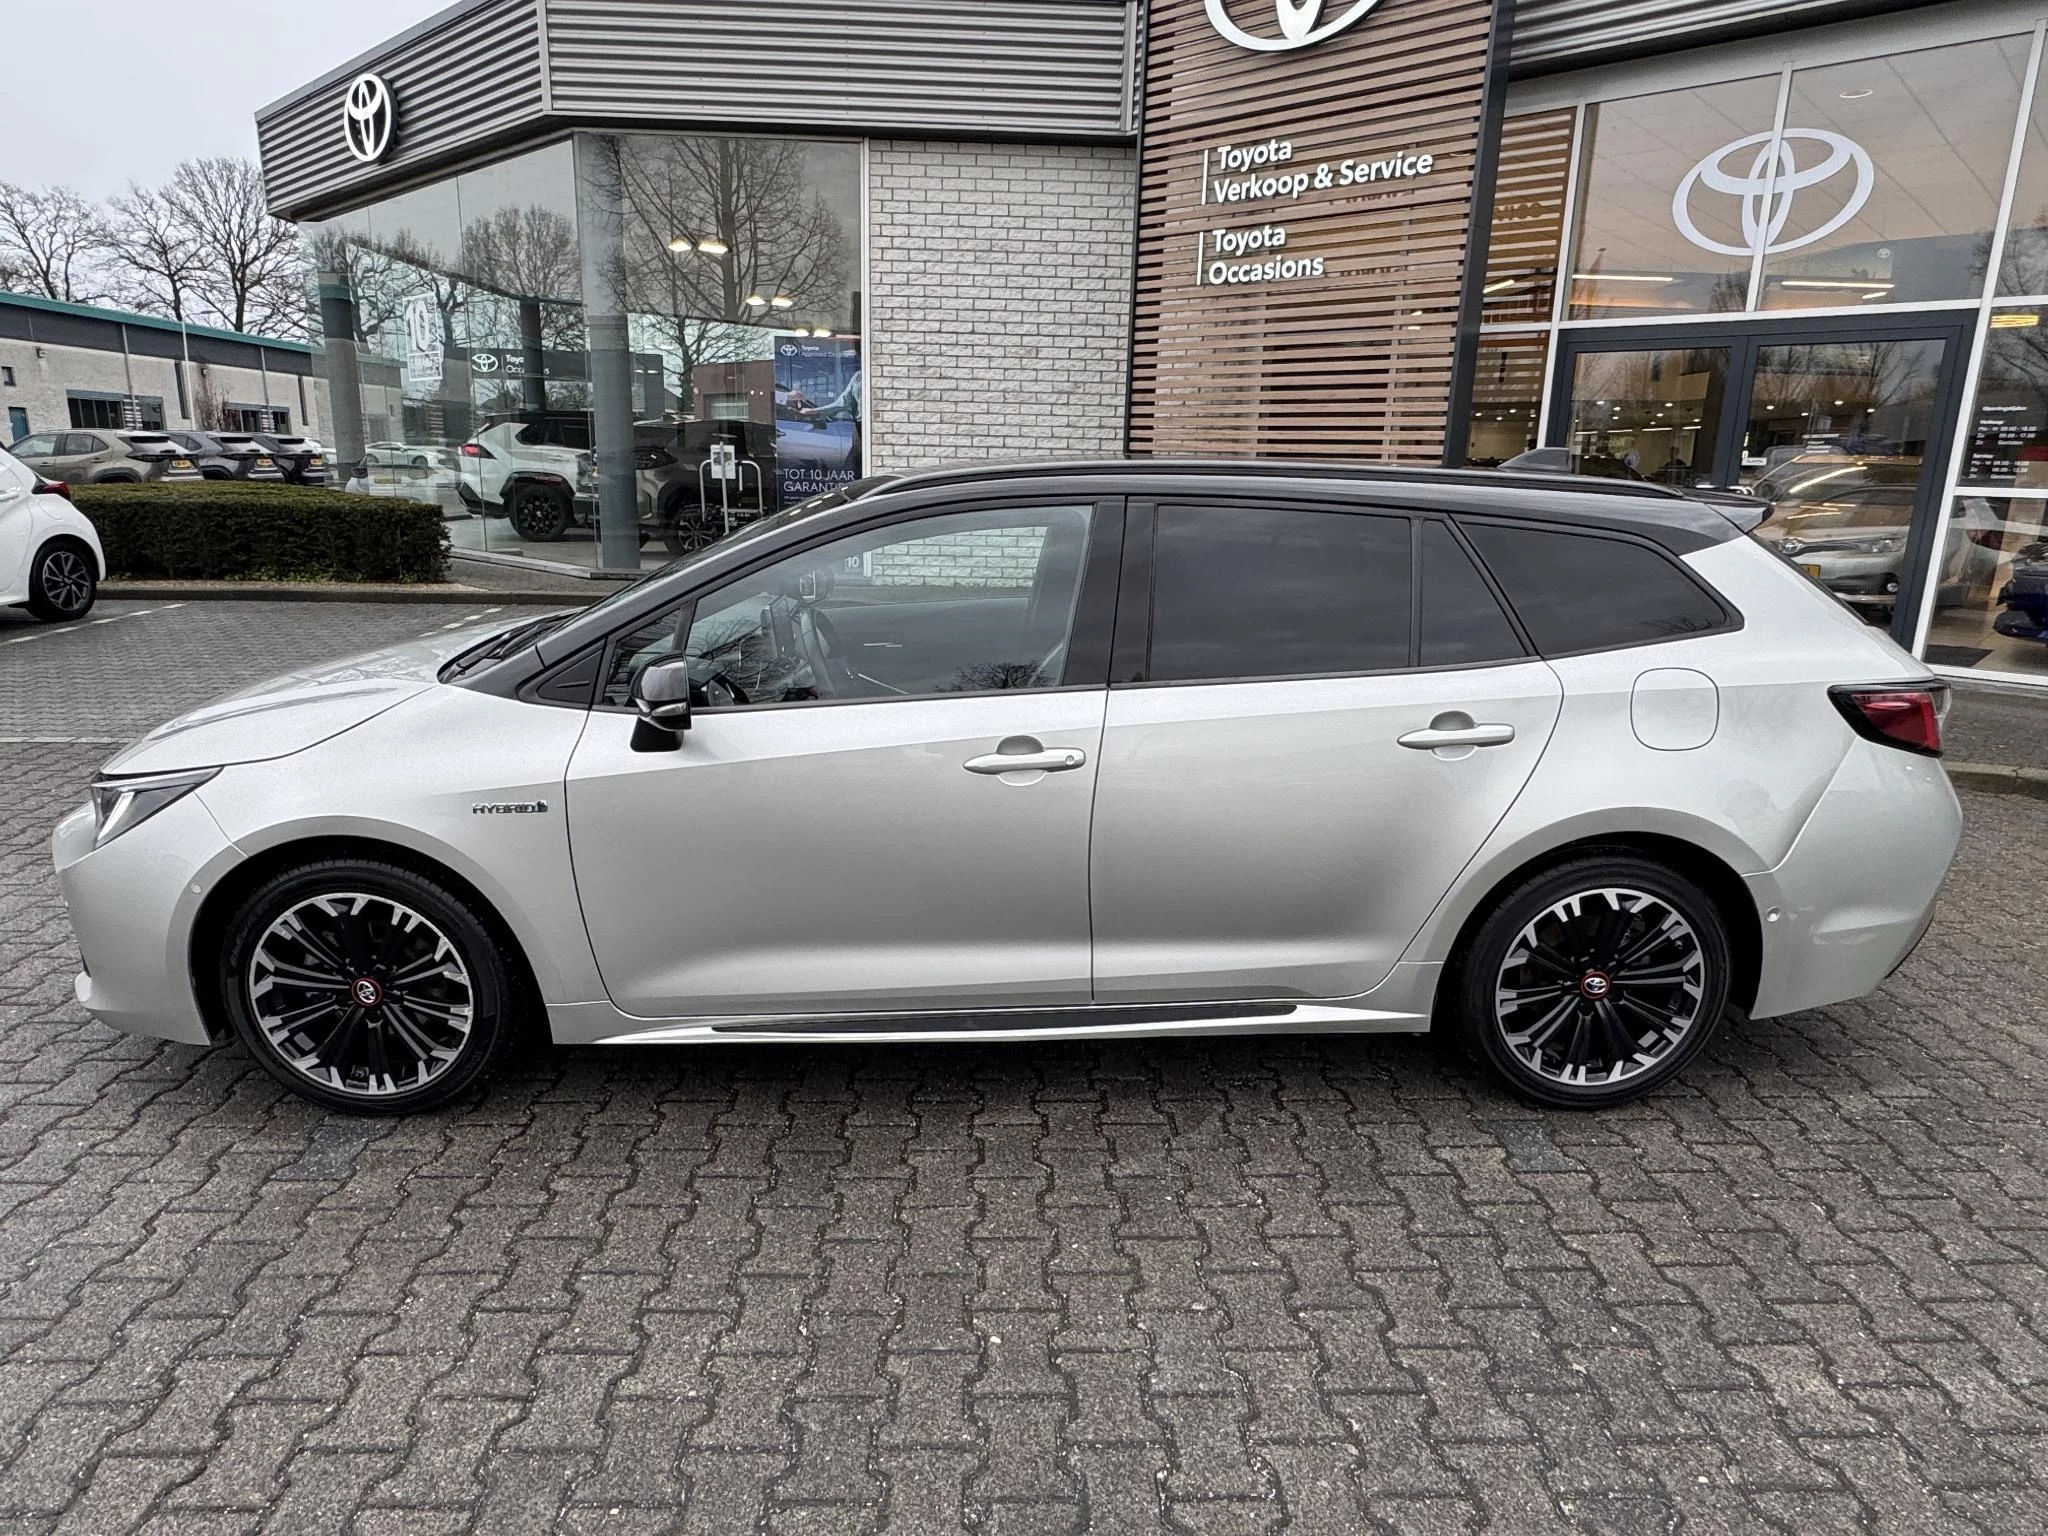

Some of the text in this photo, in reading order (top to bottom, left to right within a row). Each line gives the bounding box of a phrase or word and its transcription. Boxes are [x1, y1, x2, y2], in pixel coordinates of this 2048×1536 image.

[1218, 139, 1292, 172] Toyota
[1214, 151, 1433, 202] Verkoop & Service
[1212, 225, 1286, 256] Toyota
[1208, 255, 1325, 284] Occasions
[783, 468, 855, 481] TOT 10 JAAR
